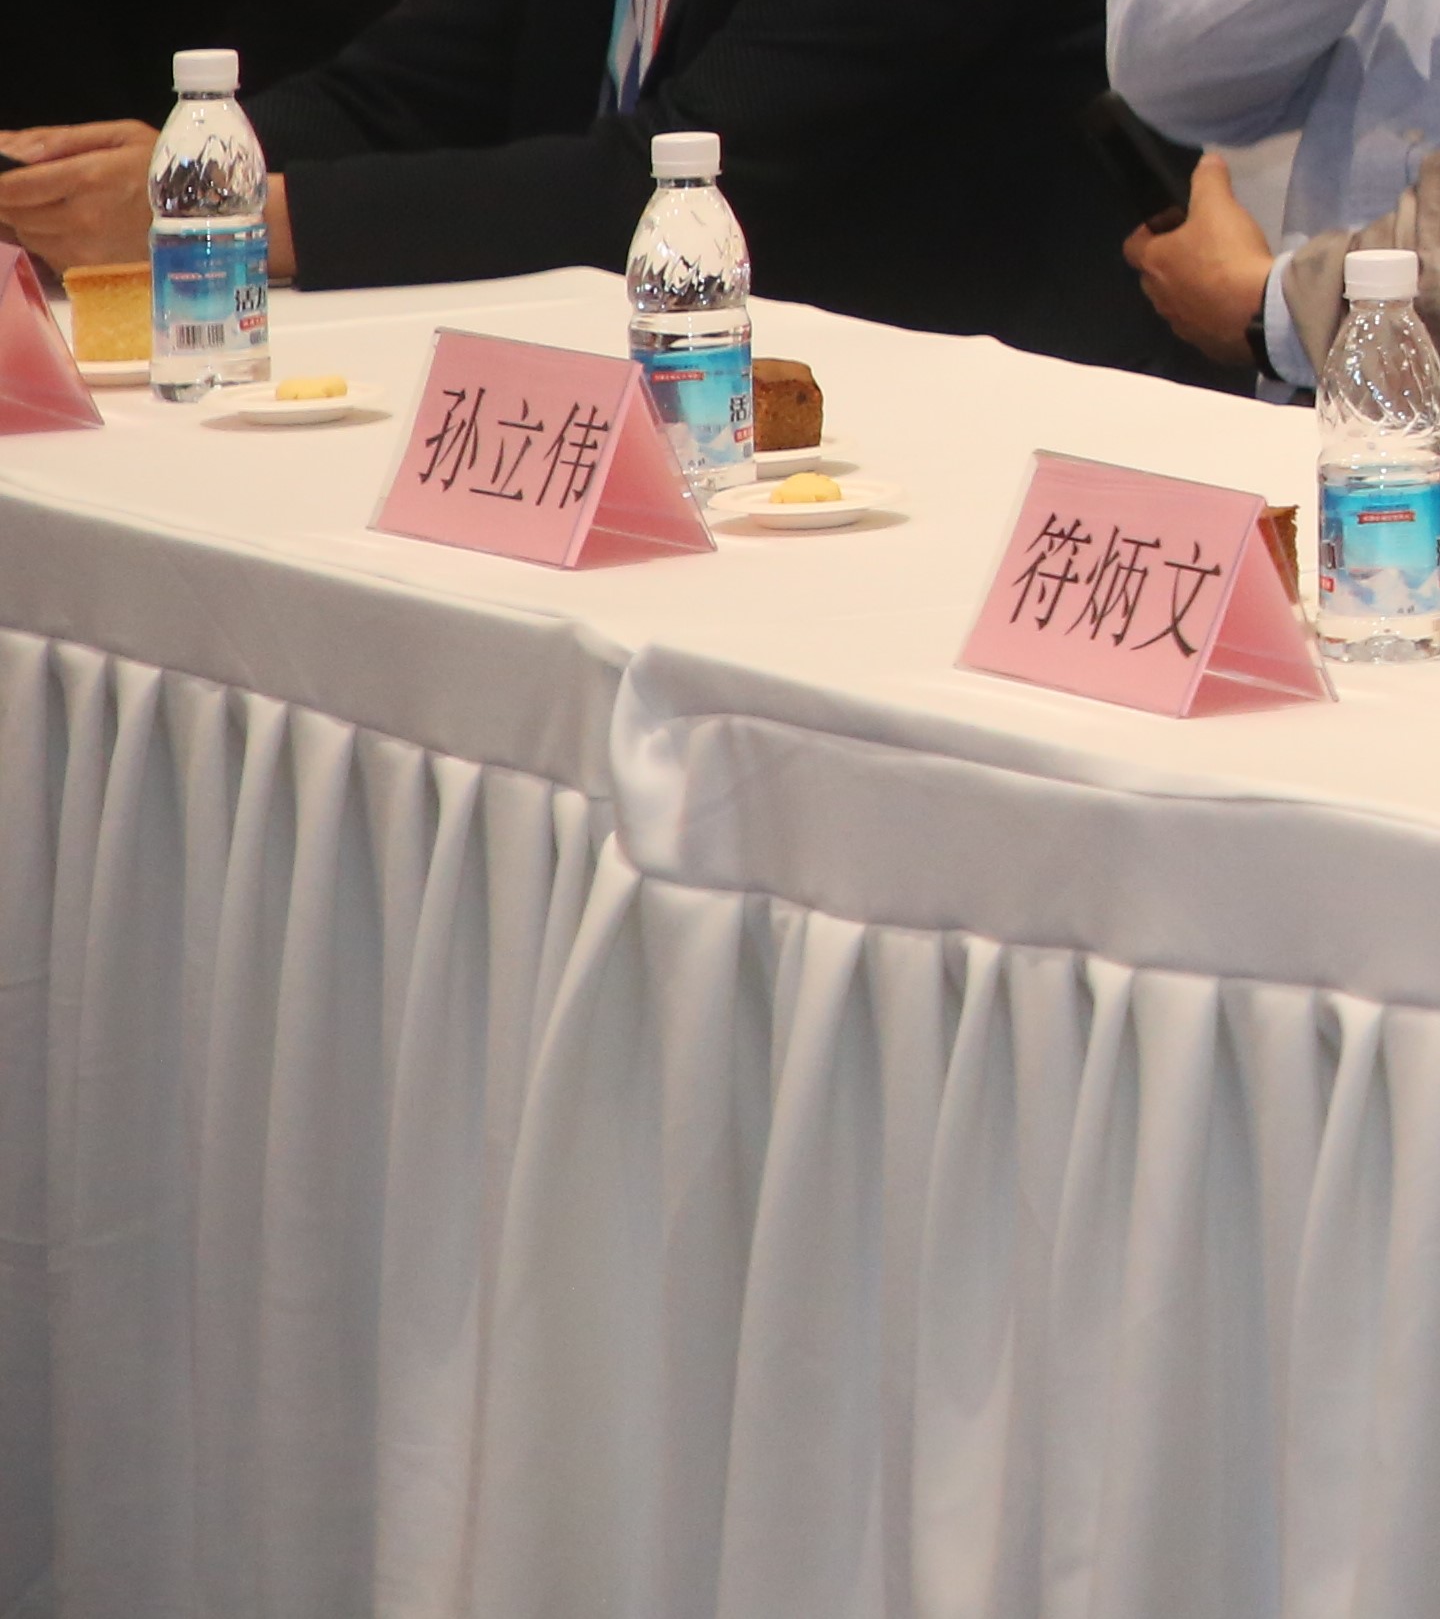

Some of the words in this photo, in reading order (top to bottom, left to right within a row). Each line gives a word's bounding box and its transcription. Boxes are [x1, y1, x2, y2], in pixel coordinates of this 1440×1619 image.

[418, 387, 609, 509] 孙立伟
[1010, 512, 1221, 658] 符炳文
